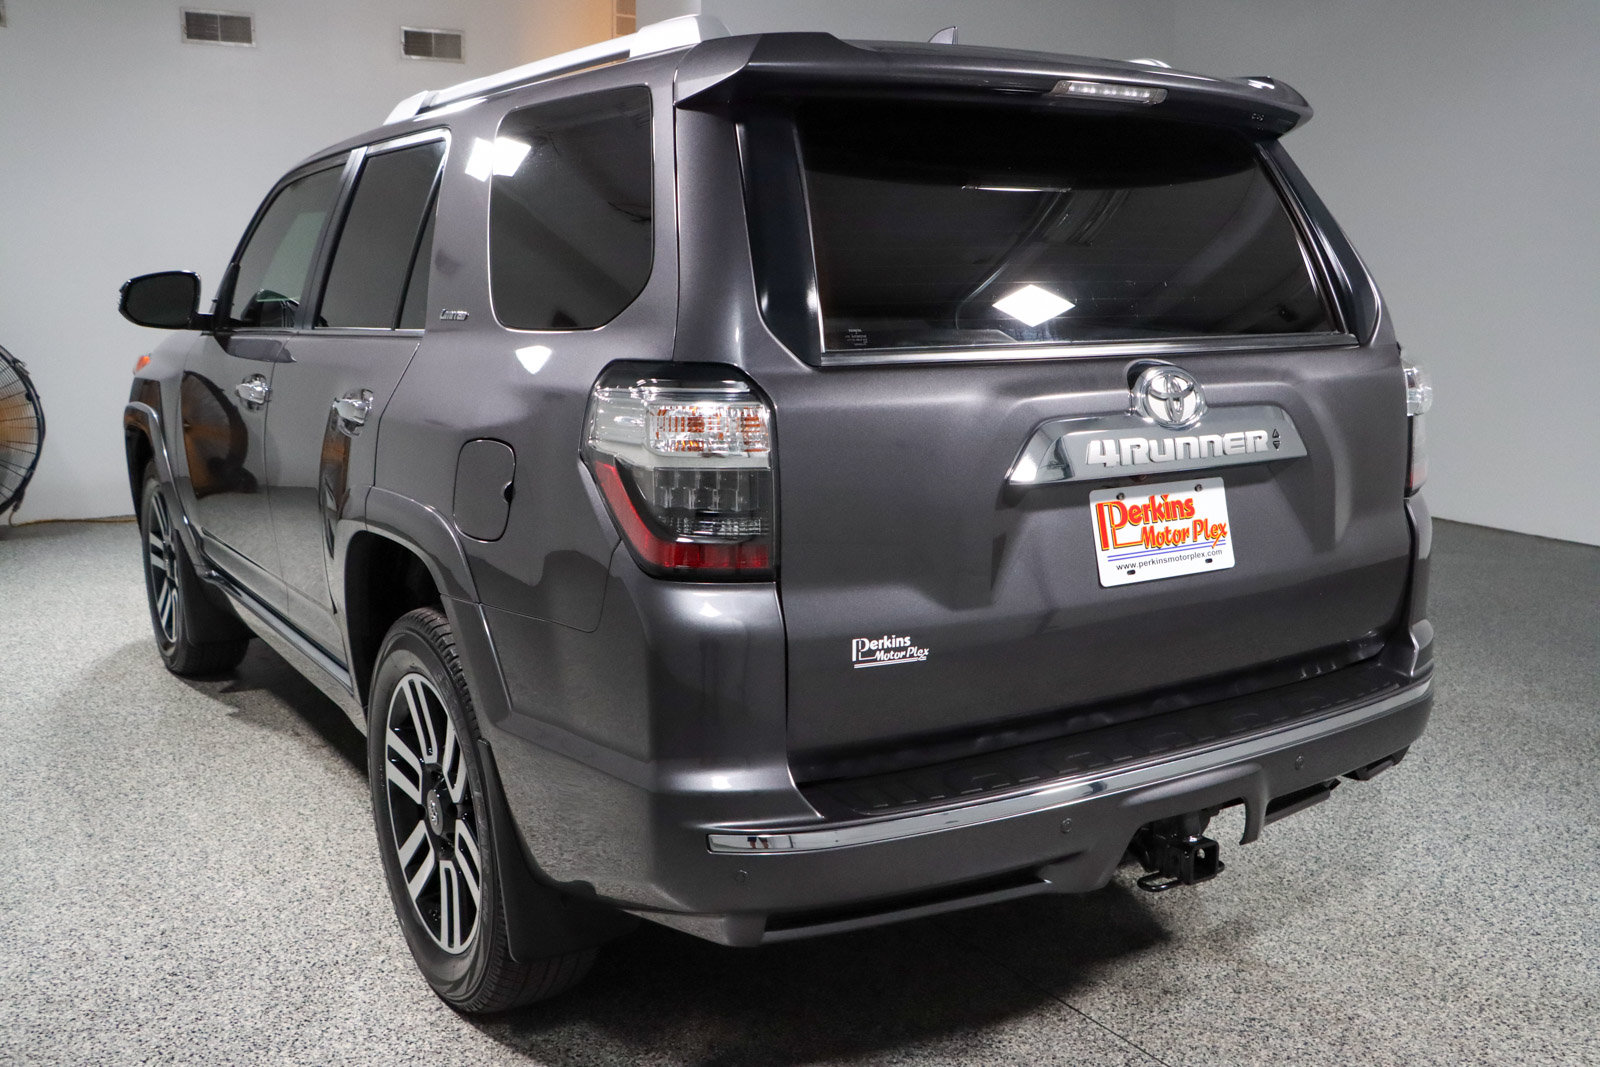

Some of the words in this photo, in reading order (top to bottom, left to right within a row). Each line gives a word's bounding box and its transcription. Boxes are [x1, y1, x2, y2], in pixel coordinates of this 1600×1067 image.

[1087, 430, 1269, 467] 4RUNNER
[1096, 494, 1196, 550] Perkins
[1141, 525, 1190, 548] Motor
[1193, 518, 1228, 548] Plex
[1116, 549, 1223, 571] www.perkinsmotorplex.com
[852, 635, 911, 662] Perkins
[875, 650, 905, 661] Motor
[906, 646, 929, 660] Plex
